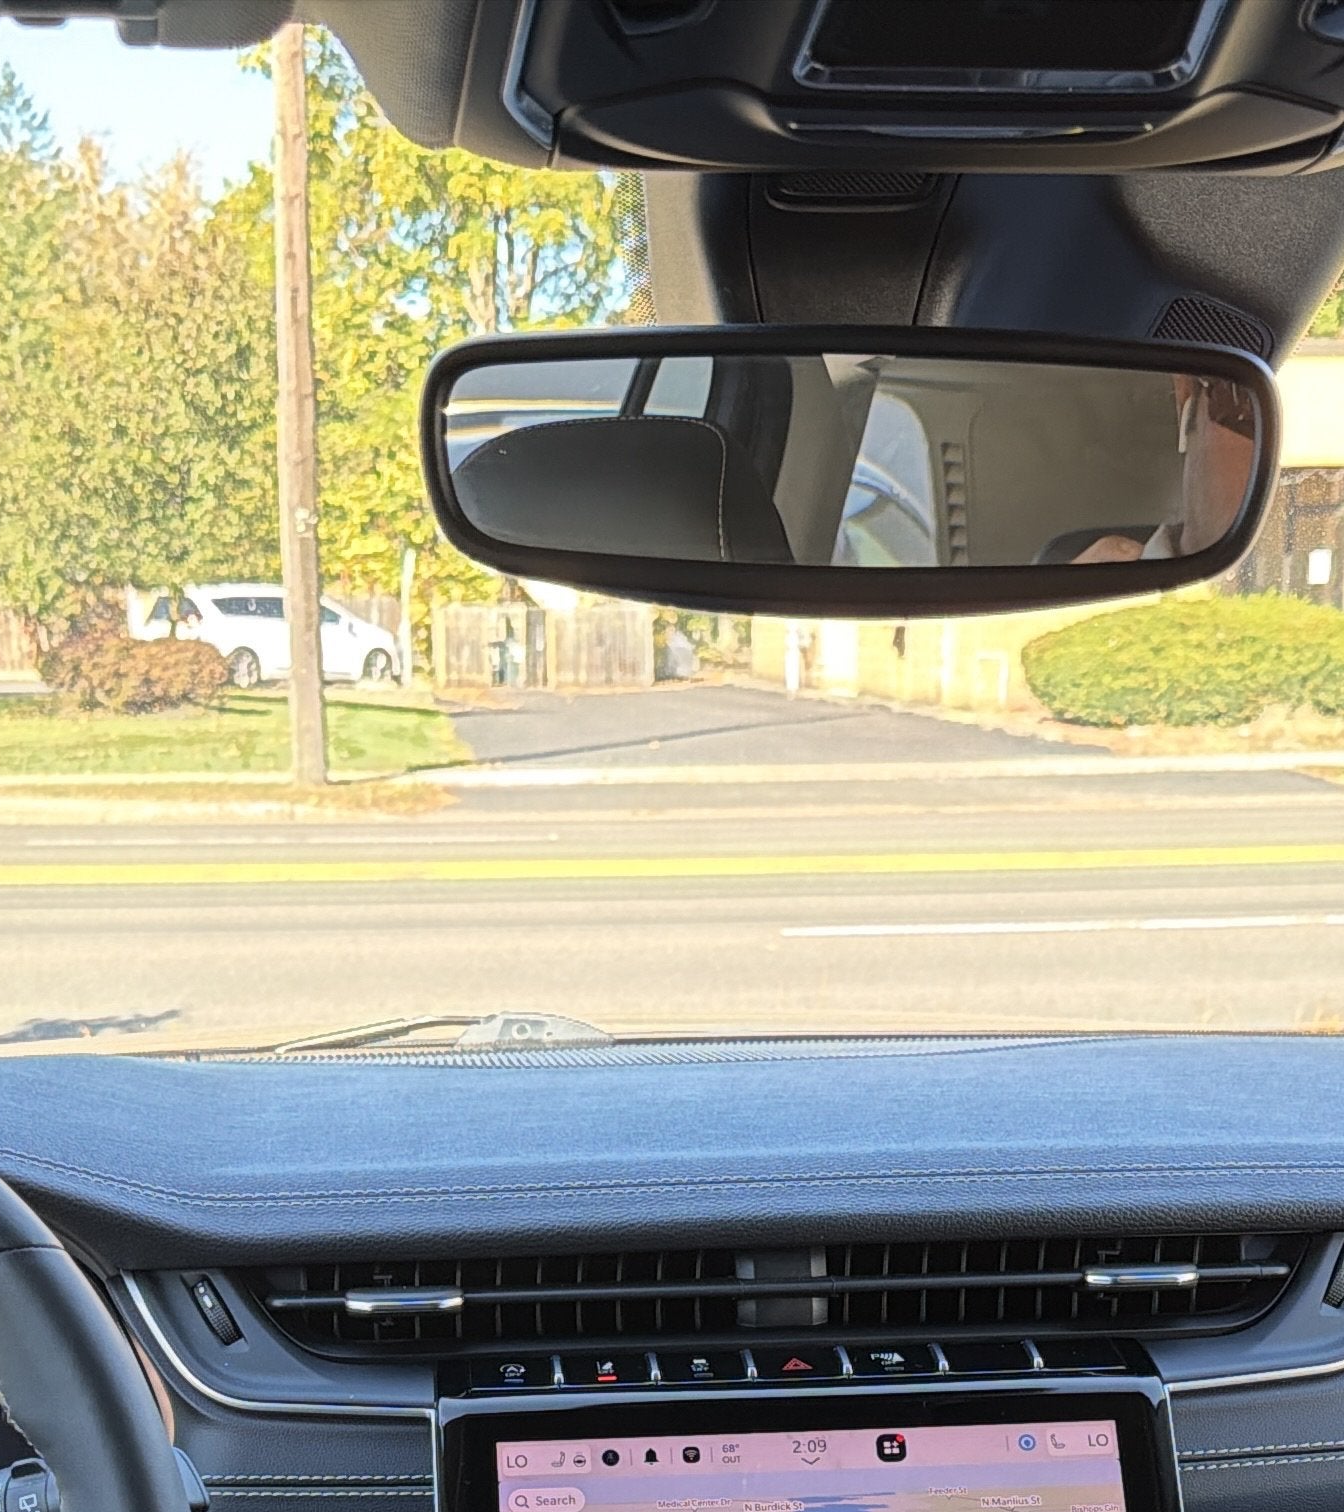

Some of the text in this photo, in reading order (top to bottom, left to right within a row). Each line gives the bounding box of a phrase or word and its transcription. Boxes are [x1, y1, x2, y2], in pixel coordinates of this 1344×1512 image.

[1088, 1434, 1109, 1447] LO
[792, 1439, 827, 1454] 2:09
[507, 1454, 528, 1468] LO
[722, 1455, 741, 1464] OUT
[929, 1486, 968, 1495] Feeder St
[536, 1494, 576, 1507] Search
[658, 1499, 732, 1509] Medical Center Dr
[982, 1496, 1041, 1506] N Manlius St
[744, 1501, 803, 1512] N Burdick St
